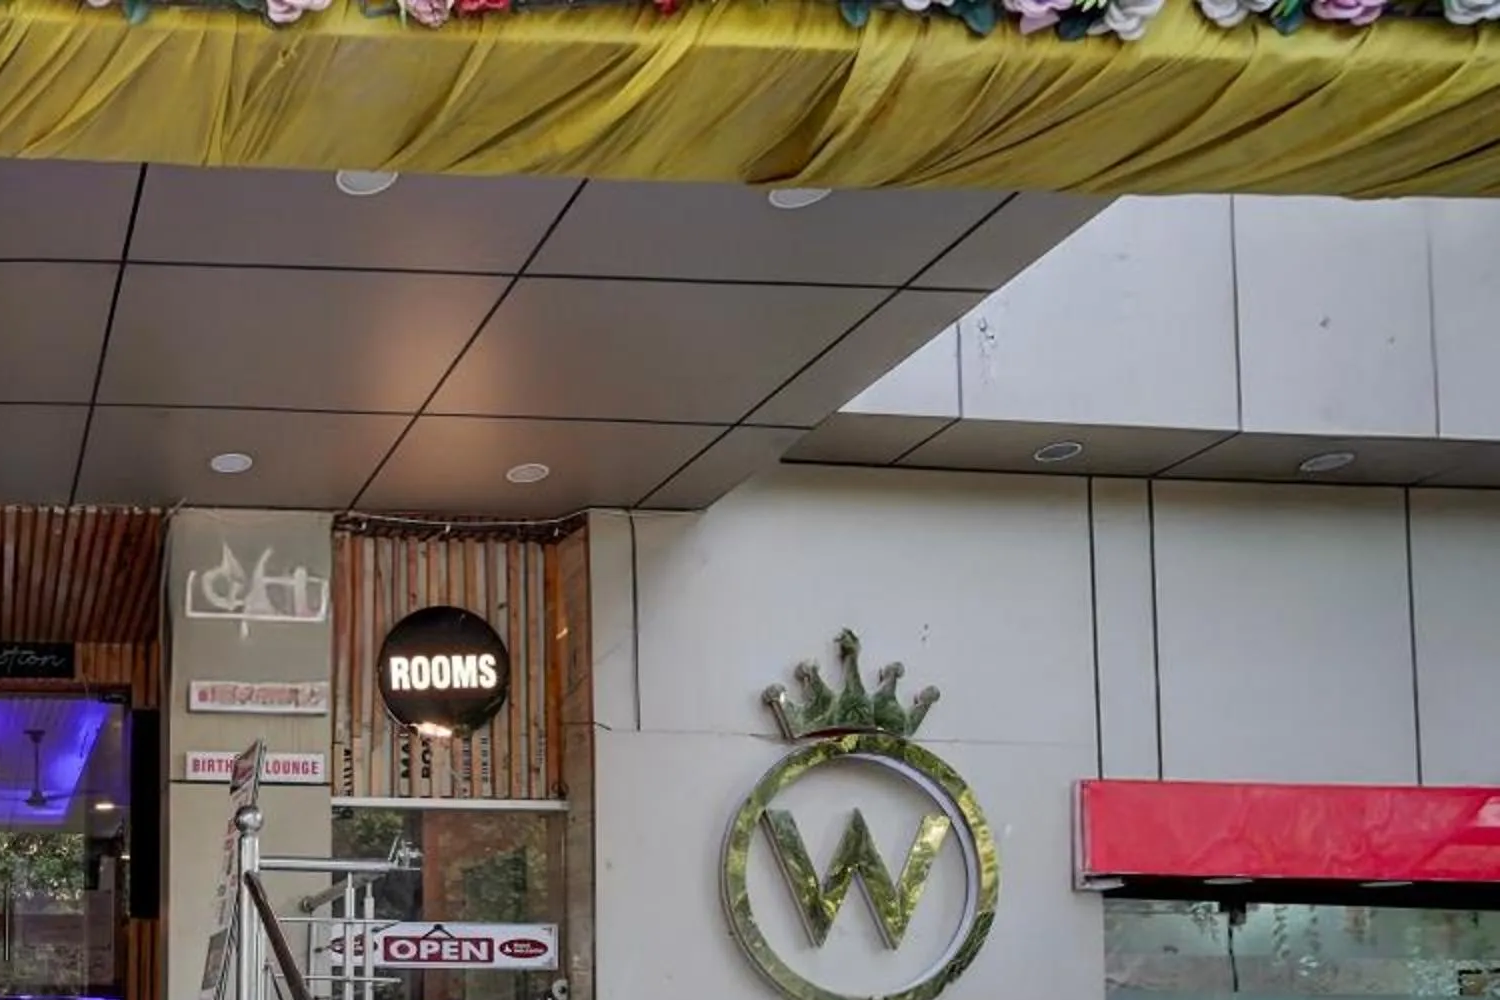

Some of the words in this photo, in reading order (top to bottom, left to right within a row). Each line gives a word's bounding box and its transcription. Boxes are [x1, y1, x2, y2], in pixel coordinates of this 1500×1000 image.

[389, 653, 498, 691] ROOMS
[265, 760, 321, 776] LOUNGE
[764, 808, 951, 950] W
[388, 938, 490, 962] OPEN
